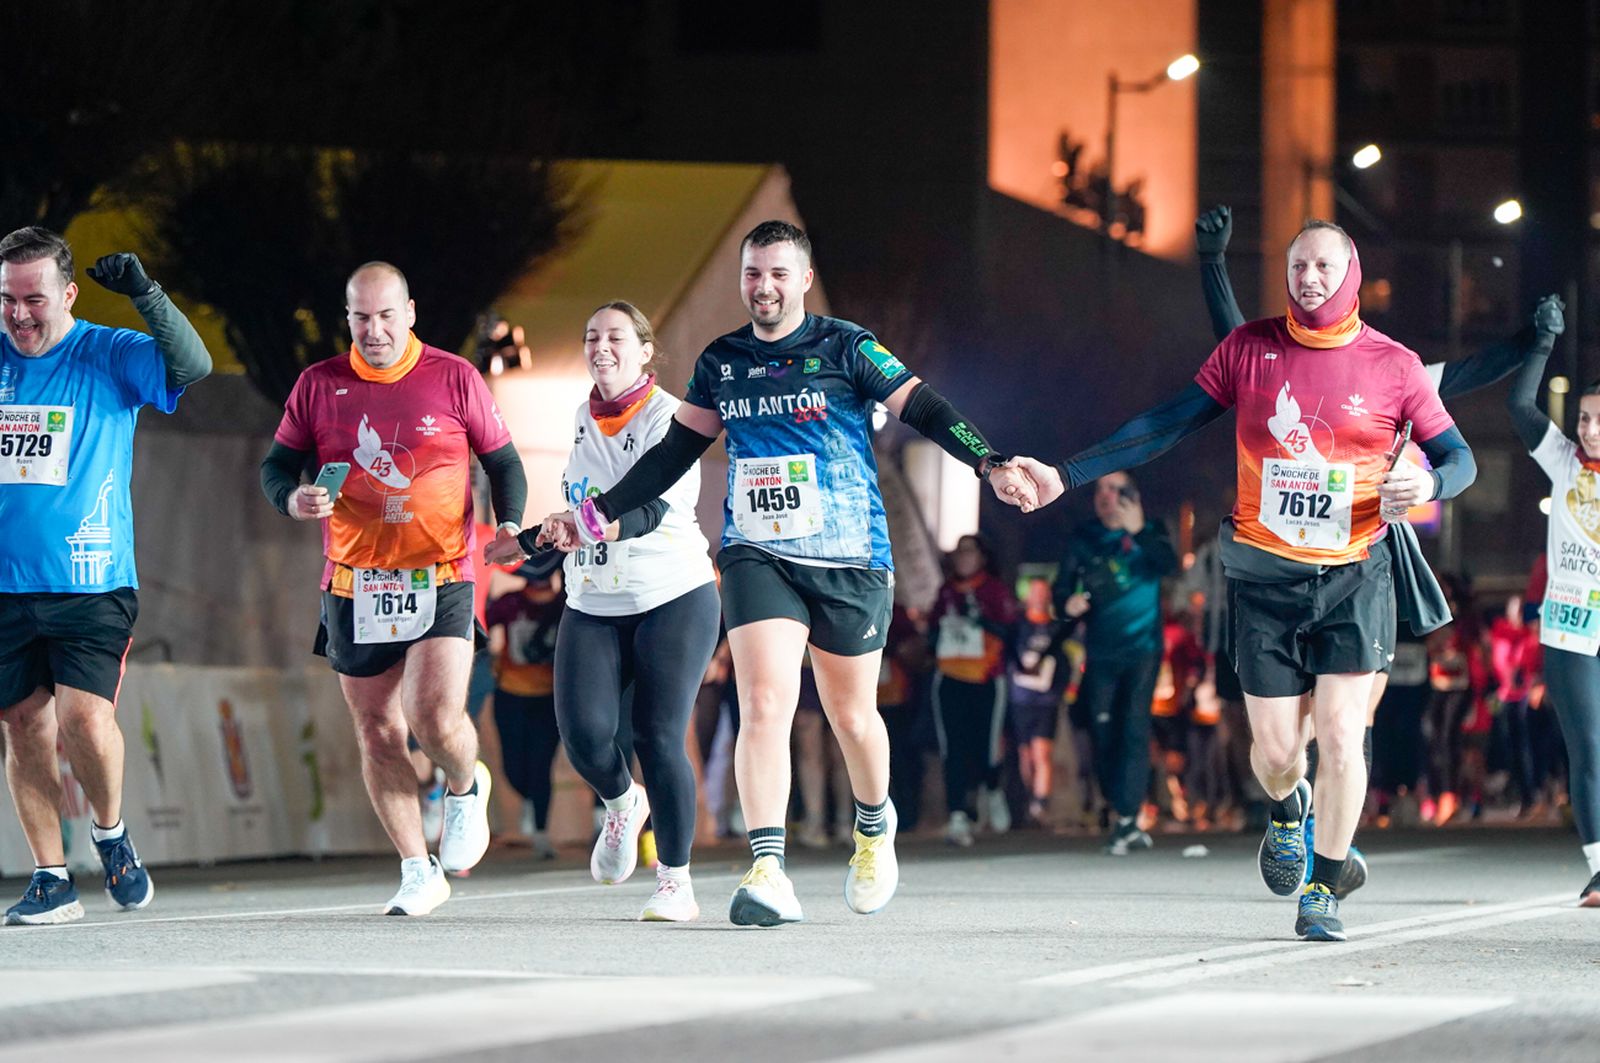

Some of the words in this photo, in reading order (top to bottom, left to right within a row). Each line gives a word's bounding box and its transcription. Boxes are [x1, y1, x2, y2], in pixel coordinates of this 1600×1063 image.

[719, 398, 752, 421] SAN
[757, 388, 827, 416] ANTÓN
[0, 423, 10, 432] AN
[4, 414, 29, 422] NOCHE
[31, 415, 40, 423] DE
[0, 434, 53, 457] 5729
[1283, 429, 1309, 454] 43
[369, 456, 392, 478] 43
[769, 466, 780, 475] DE
[1280, 470, 1309, 480] NOCHE
[1309, 472, 1320, 481] DE
[1270, 480, 1287, 489] SAN
[1288, 480, 1319, 491] ANTÓN
[747, 485, 801, 513] 1459
[1278, 491, 1333, 519] 7612
[1560, 541, 1587, 558] SAN
[1560, 557, 1600, 576] ANTO
[372, 592, 418, 617] 7614
[1549, 601, 1592, 629] 9597
